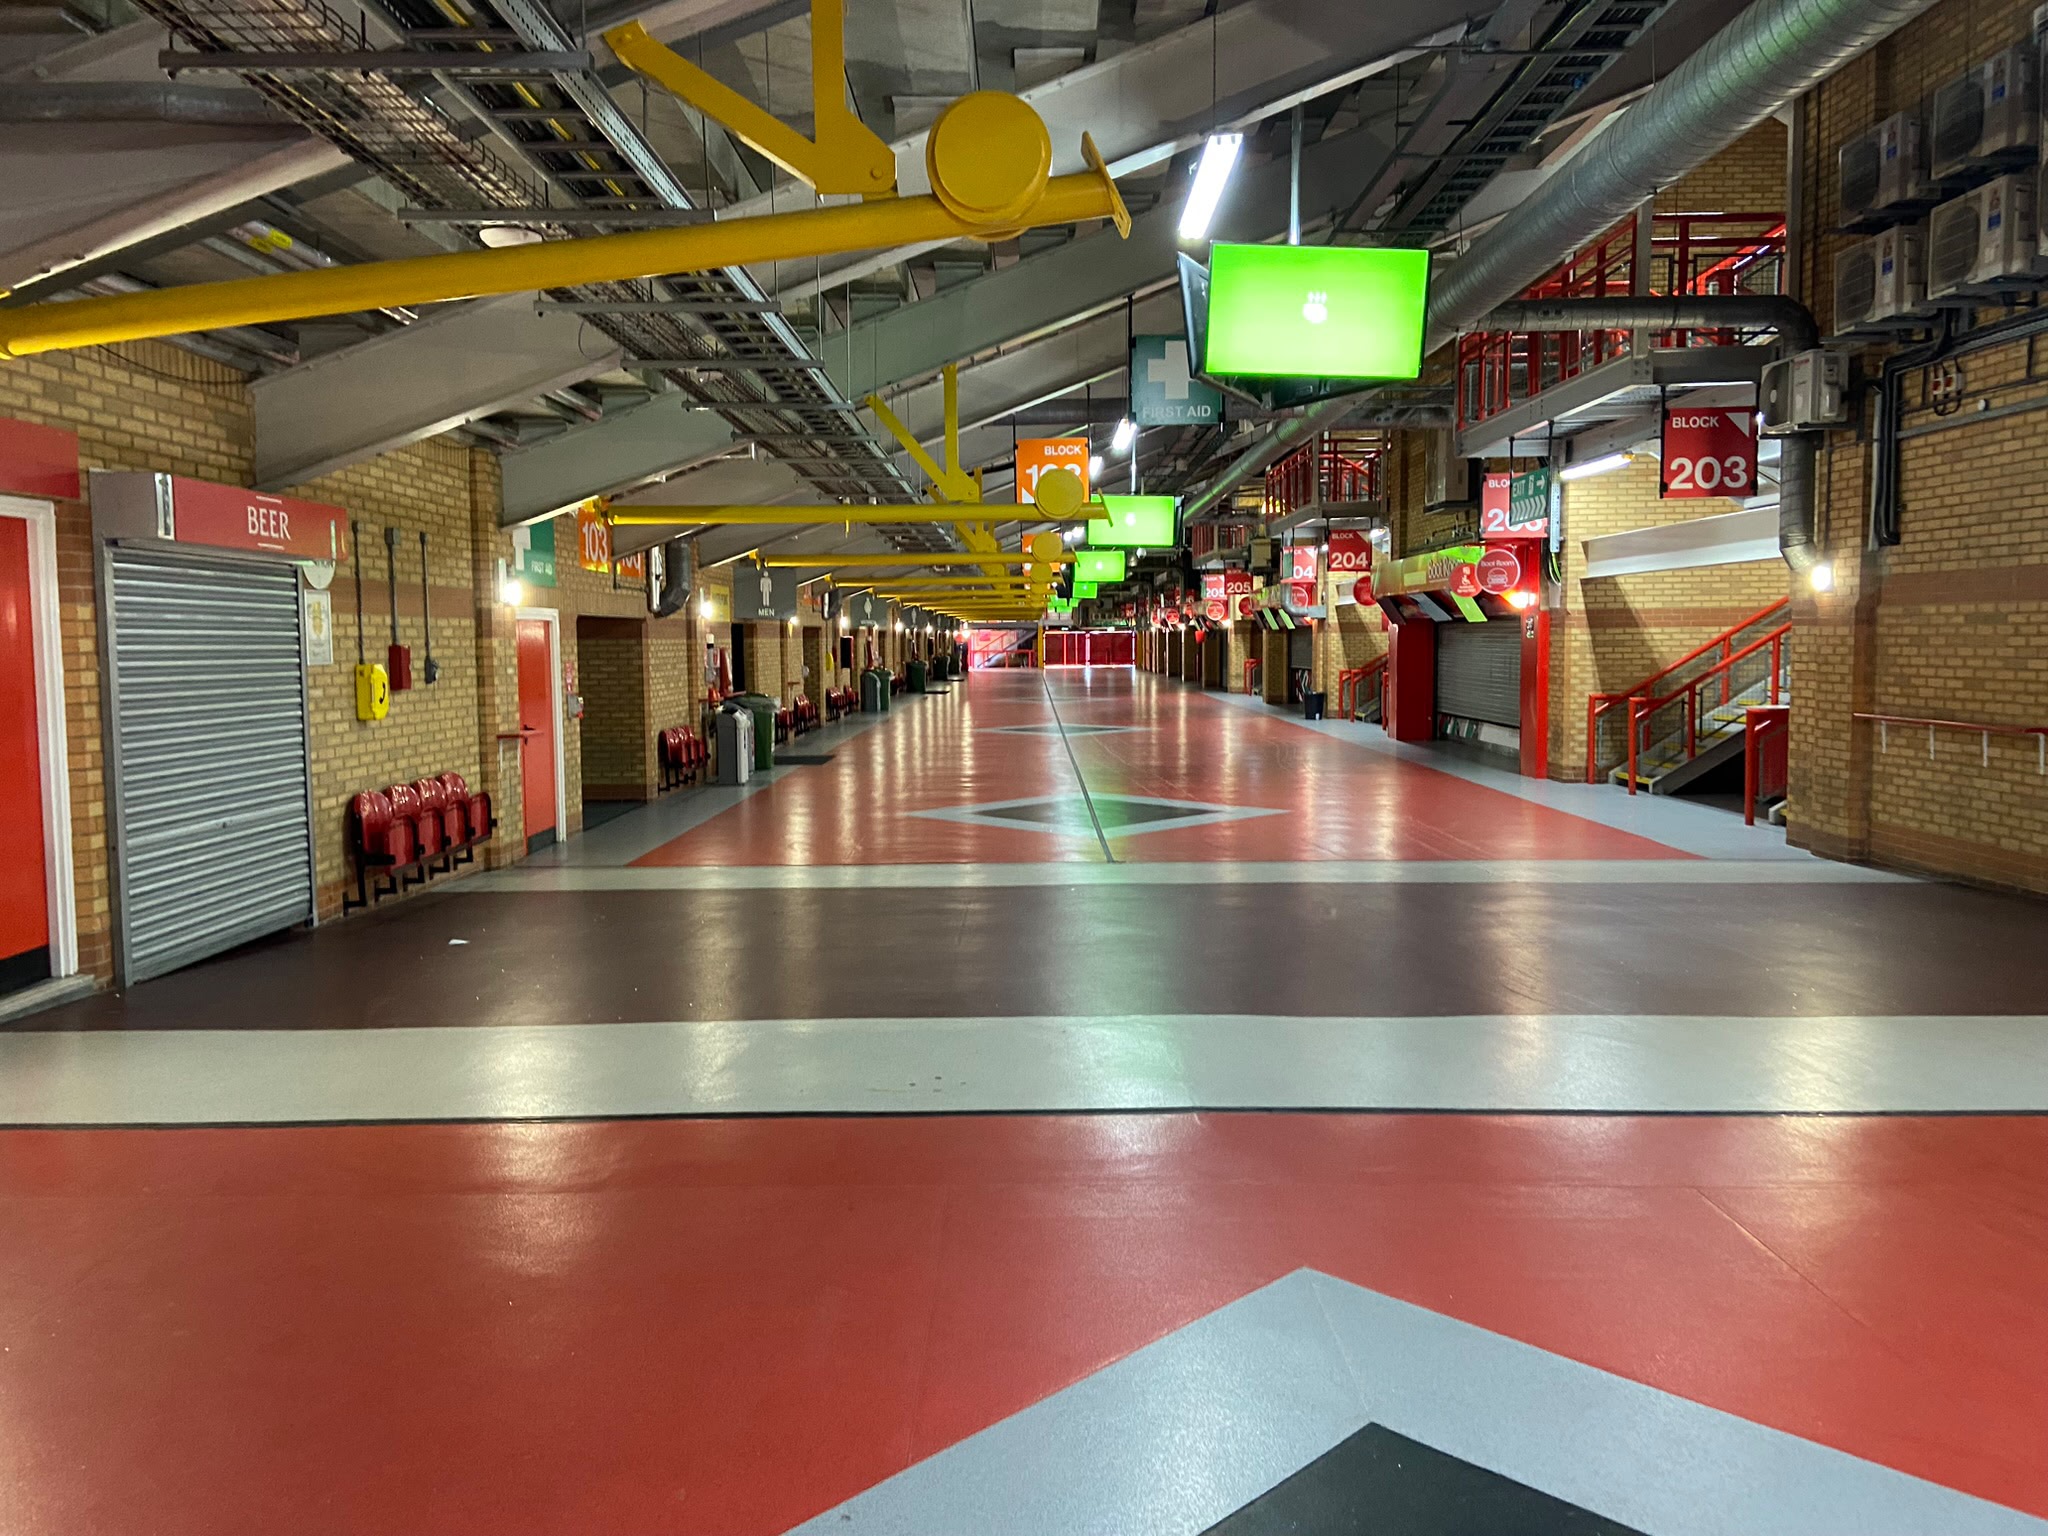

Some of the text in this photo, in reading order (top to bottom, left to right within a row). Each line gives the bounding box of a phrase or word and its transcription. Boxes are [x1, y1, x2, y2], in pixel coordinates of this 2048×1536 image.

[1142, 405, 1211, 418] FIRST AID
[1672, 415, 1719, 429] BLOCK
[1044, 444, 1082, 456] BLOCK
[1670, 455, 1748, 489] 203
[1489, 478, 1511, 488] BLO
[1512, 480, 1526, 497] EXIT
[247, 506, 292, 540] BEER
[582, 520, 608, 563] 103
[1331, 551, 1368, 568] 204
[531, 560, 544, 574] FIRST
[1226, 581, 1251, 593] 205
[758, 608, 775, 617] MEN
